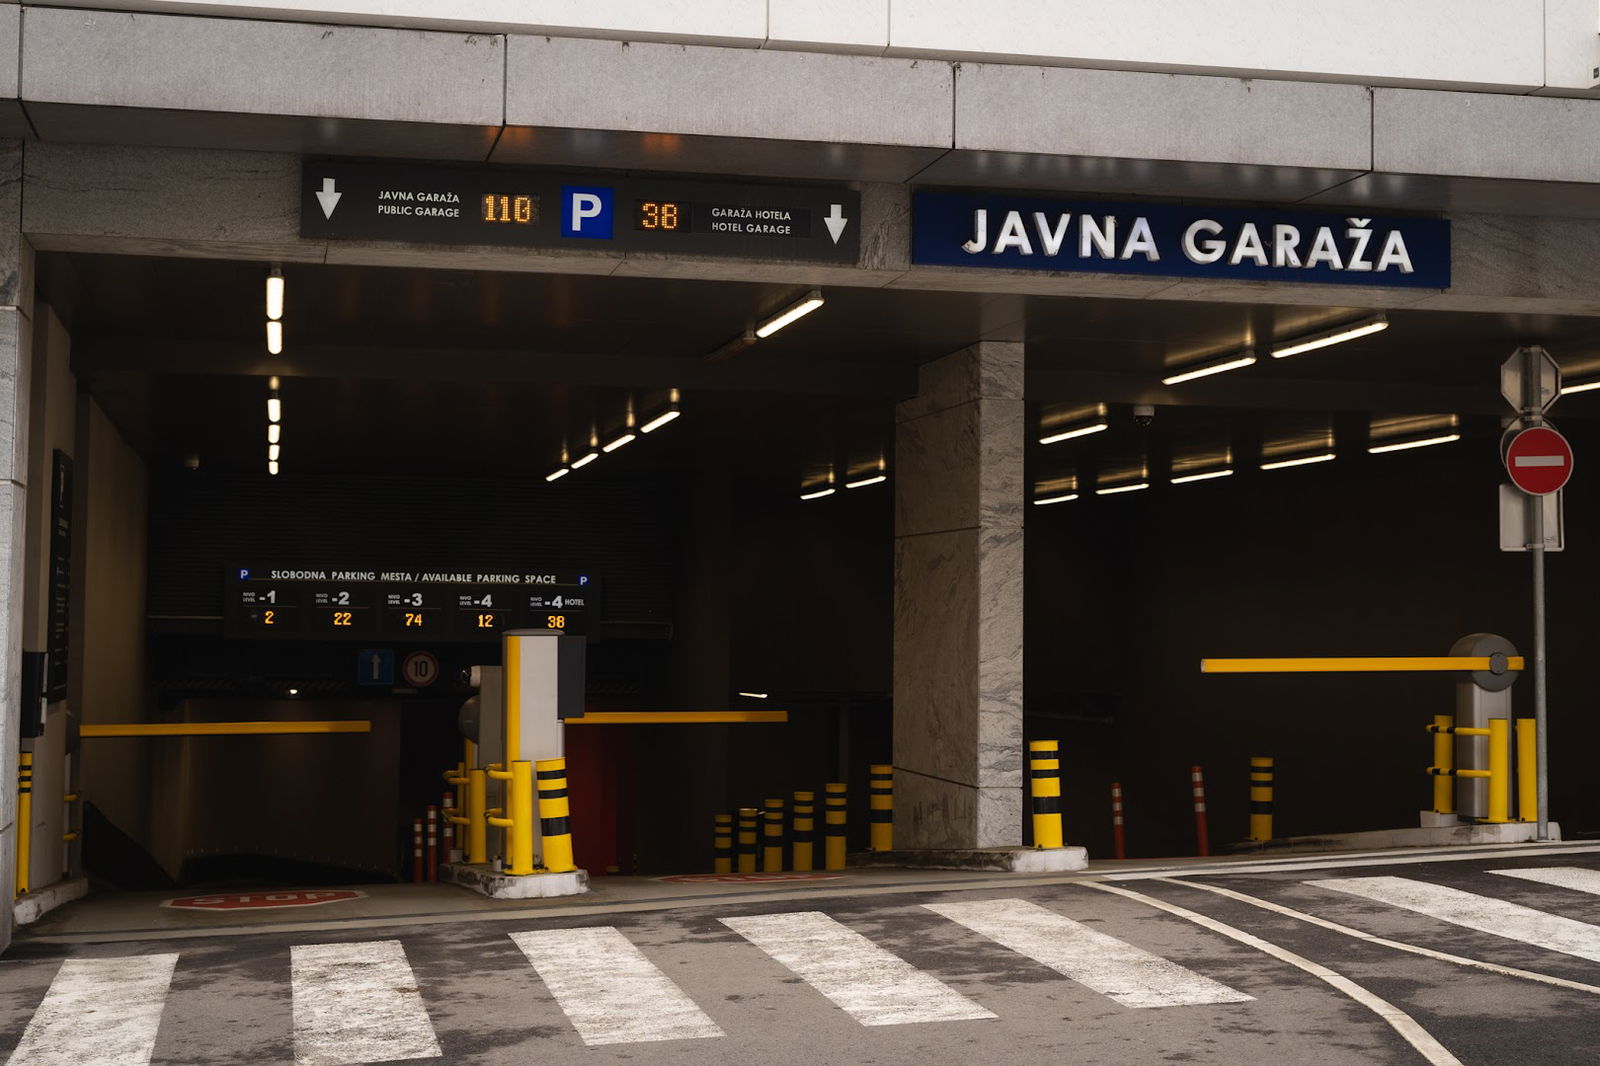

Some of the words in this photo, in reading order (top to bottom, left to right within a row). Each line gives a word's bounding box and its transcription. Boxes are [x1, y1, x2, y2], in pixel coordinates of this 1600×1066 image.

[378, 190, 413, 202] JAVNA
[416, 192, 460, 203] GARAŽA
[378, 204, 412, 216] PUBLIC
[415, 206, 460, 218] GARAGE
[484, 195, 531, 222] 110
[571, 193, 603, 231] P
[711, 207, 752, 218] GARAŽA
[755, 210, 791, 221] HOTELA
[642, 203, 678, 229] 38
[711, 222, 743, 232] HOTEL
[746, 224, 791, 235] GARAGE
[961, 208, 1160, 262] JAVNA
[1181, 217, 1415, 274] GARAŽA
[240, 570, 248, 579] P
[271, 570, 326, 580] SLOBODNA
[332, 571, 376, 580] PARKING
[380, 572, 412, 581] MESTA
[414, 572, 420, 582] /
[421, 573, 472, 582] AVAILABLE
[477, 574, 520, 583] PARKING
[525, 574, 556, 584] SPACE
[580, 576, 588, 585] P
[259, 590, 276, 604] -1
[331, 592, 350, 605] -2
[404, 593, 423, 606] -3
[474, 594, 492, 607] -4
[544, 595, 563, 608] -4
[564, 598, 584, 606] HOTEL
[264, 610, 274, 624] 2
[333, 612, 352, 625] 22
[405, 614, 422, 627] 74
[478, 615, 494, 628] 12
[547, 616, 565, 628] 38
[414, 660, 428, 677] 10
[193, 892, 335, 904] STOP
